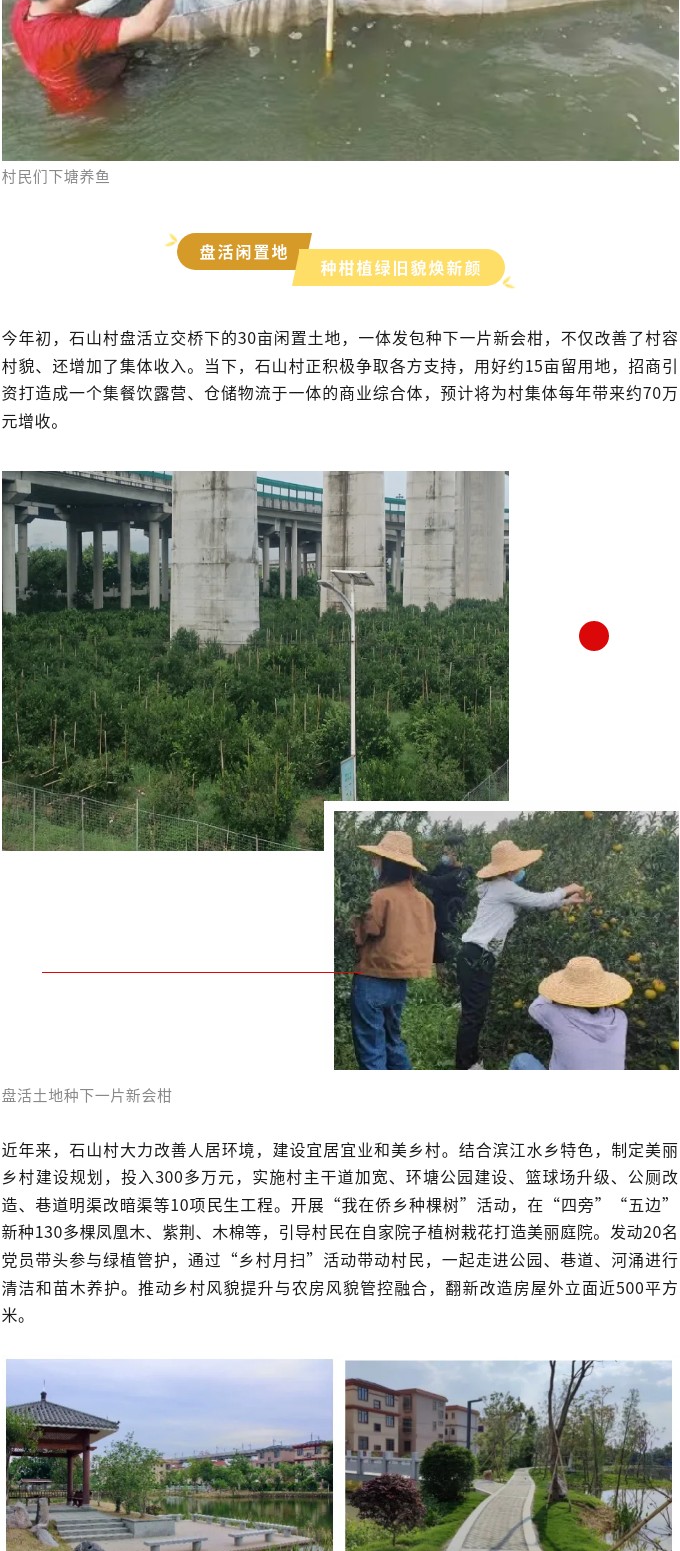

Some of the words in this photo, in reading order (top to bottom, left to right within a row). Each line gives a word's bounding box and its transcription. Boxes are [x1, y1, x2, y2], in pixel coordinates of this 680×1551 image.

[200, 244, 288, 260] 盘活闲置地
[321, 260, 480, 276] 种柑植绿旧貌焕新颜
[2, 330, 677, 346] 今年初，石山村盘活立交桥下的30亩闲置土地，一体发包种下一片新会柑，不仅改善了村容
[2, 358, 677, 374] 村貌、还增加了集体收入。当下，石山村正积极争取各方支持，用好约15亩留用地，招商引
[2, 385, 677, 401] 资打造成一个集餐饮露营、仓储物流于一体的商业综合体，预计将为村集体每年带来约70万
[2, 413, 58, 429] 元增收。
[2, 1142, 677, 1158] 近年来，石山村大力改善人居环境，建设宜居宜业和美乡村。结合滨江水乡特色，制定美丽
[2, 1169, 677, 1185] 乡村建设规划，投入300多万元，实施村主干道加宽、环塘公园建设、篮球场升级、公厕改
[2, 1224, 677, 1240] 新种130多棵凤凰木、紫荆、木棉等，引导村民在自家院子植树栽花打造美丽庭院。发动20名
[2, 1252, 677, 1268] 党员带头参与绿植管护，通过“乡村月扫”活动带动村民，一起走进公园、巷道、河涌进行
[2, 1280, 677, 1296] 清洁和苗木养护。推动乡村风貌提升与农房风貌管控融合，翻新改造房屋外立面近500平方
[2, 1307, 25, 1323] 米。
